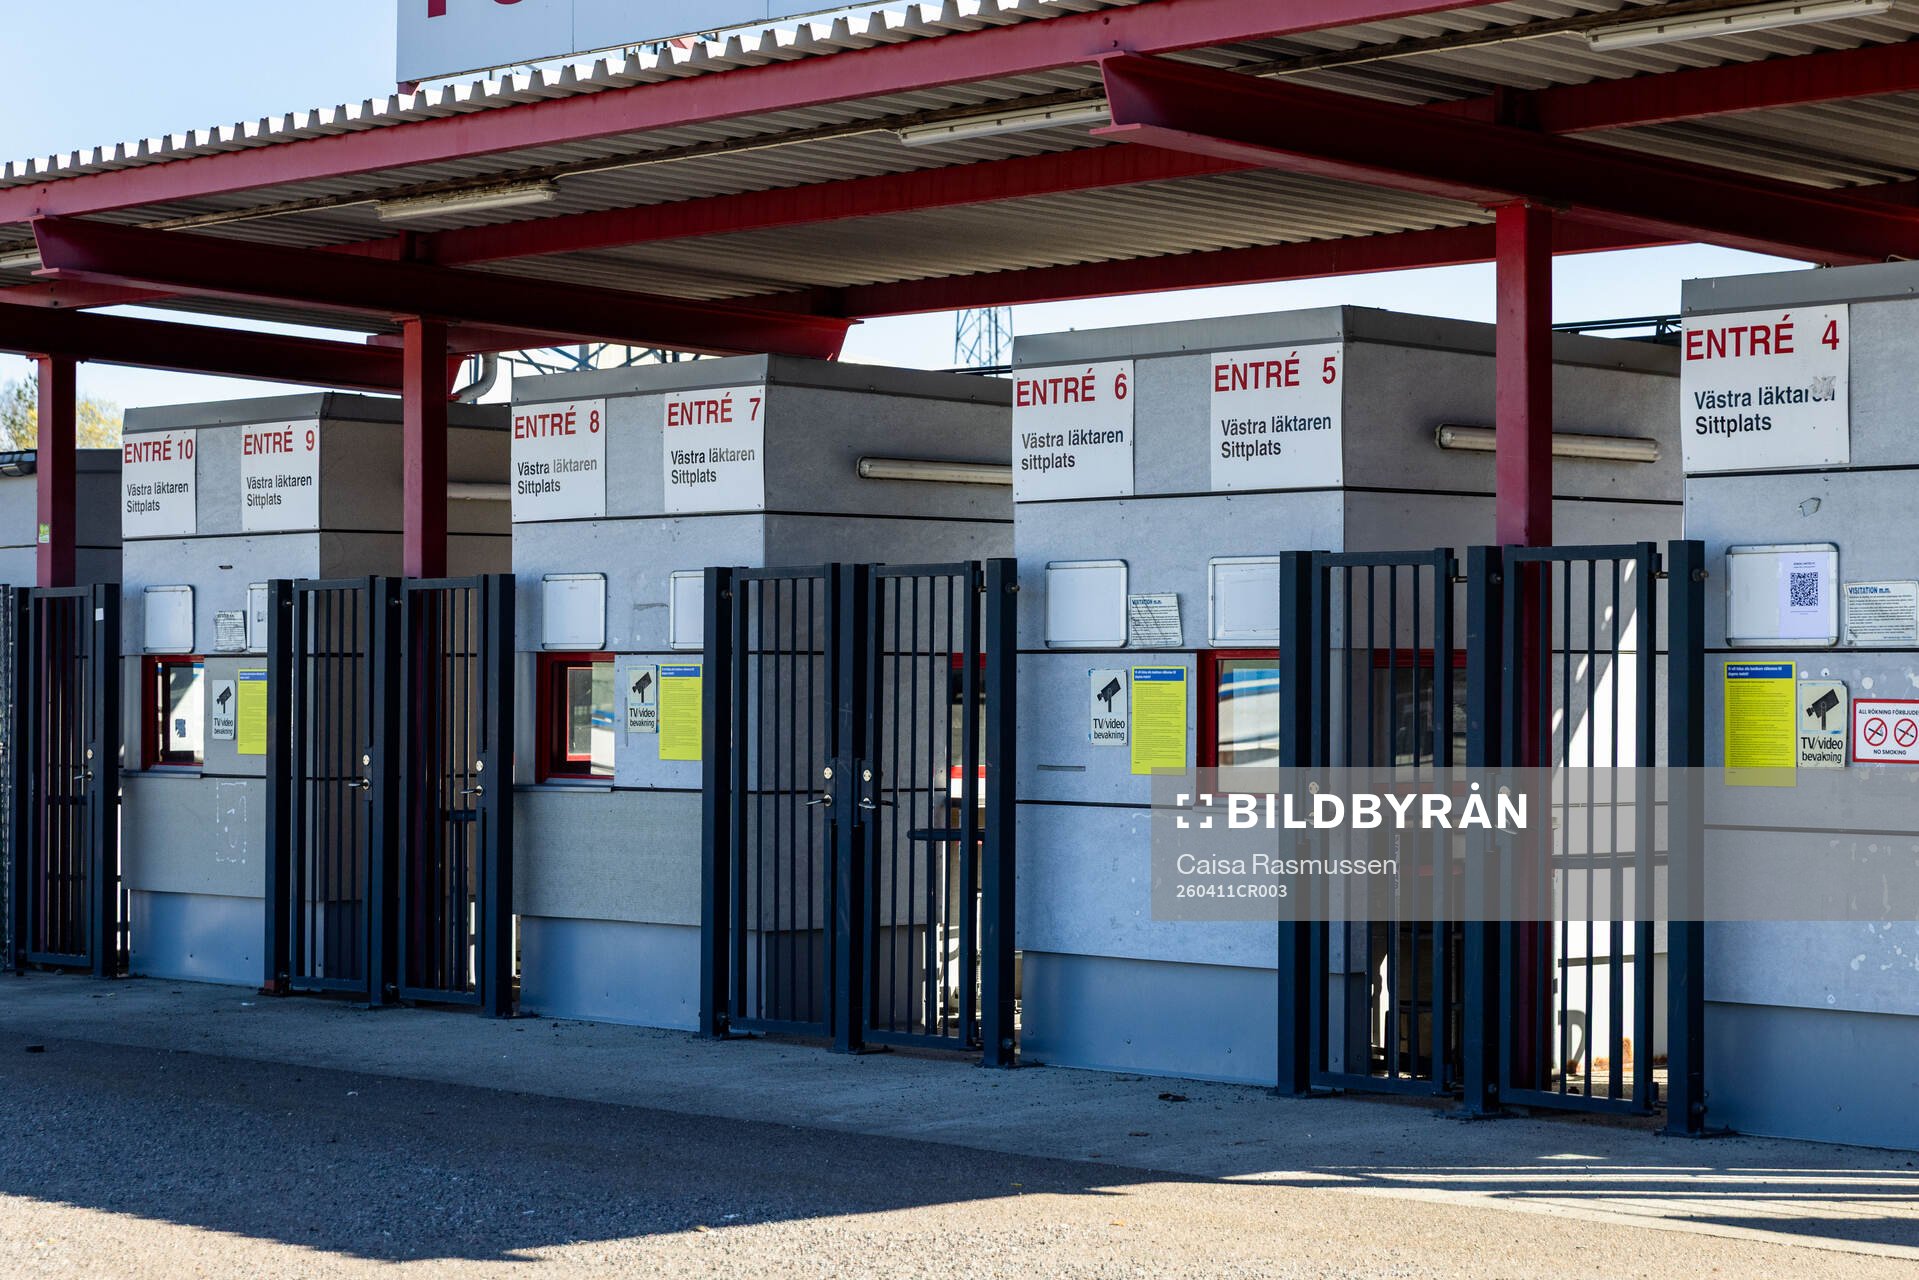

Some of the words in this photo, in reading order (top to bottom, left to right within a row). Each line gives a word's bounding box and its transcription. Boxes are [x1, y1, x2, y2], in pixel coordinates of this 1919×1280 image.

[1686, 314, 1794, 361] ENTRÉ
[1821, 320, 1840, 350] 4
[1214, 351, 1300, 392] ENTRÉ
[1322, 357, 1337, 385] 5
[1016, 368, 1096, 407] ENTRÉ
[1114, 373, 1128, 400] 6
[667, 392, 733, 427] ENTRÉ
[749, 397, 761, 422] 7
[1694, 390, 1752, 410] Västra
[514, 405, 577, 440] ENTRÉ
[589, 410, 600, 434] 8
[1221, 418, 1267, 437] Västra
[1271, 414, 1332, 434] läktaren
[1695, 413, 1773, 438] Sittplats
[243, 425, 293, 455] ENTRÉ
[305, 430, 315, 452] 9
[1021, 431, 1064, 450] Västra
[1068, 427, 1124, 446] läktaren
[124, 434, 172, 464] ENTRÉ
[177, 438, 194, 460] 10
[671, 450, 705, 466] Västra
[708, 447, 756, 463] läktaren
[1221, 439, 1282, 460] Sittplats
[517, 461, 550, 477] Västra
[553, 458, 598, 474] läktaren
[1021, 452, 1076, 474] sittplats
[246, 476, 273, 491] Västra
[275, 474, 312, 489] läktaren
[517, 479, 561, 497] Sittplats
[671, 468, 717, 488] Sittplats
[126, 482, 152, 497] Västra
[154, 481, 189, 495] läktaren
[126, 500, 160, 515] Sittplats
[246, 493, 282, 510] Sittplats
[1848, 586, 1878, 595] VISITATION
[629, 719, 654, 728] bevakning
[1093, 730, 1125, 741] bevakning
[1800, 736, 1844, 750] TV/video
[1801, 751, 1842, 764] bevakning
